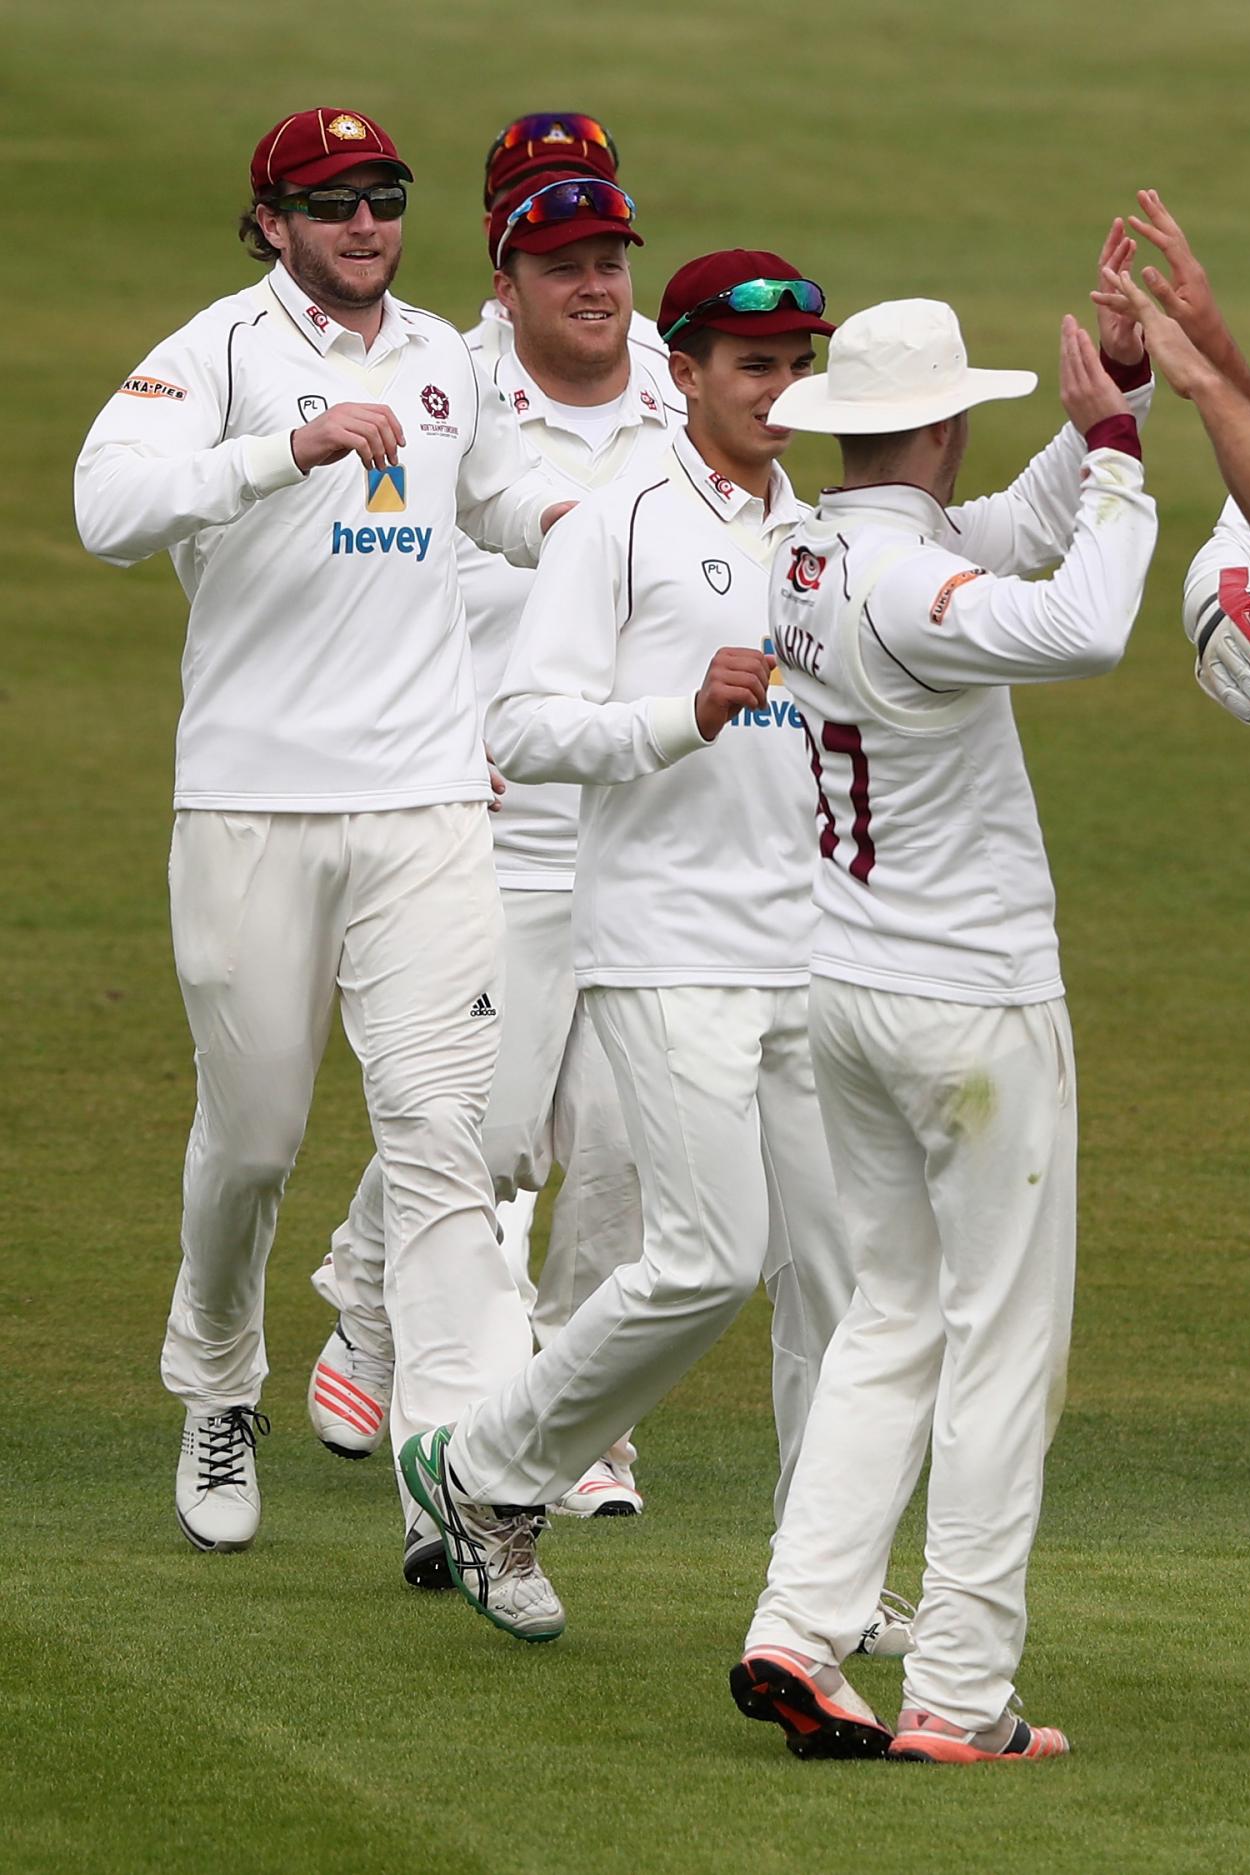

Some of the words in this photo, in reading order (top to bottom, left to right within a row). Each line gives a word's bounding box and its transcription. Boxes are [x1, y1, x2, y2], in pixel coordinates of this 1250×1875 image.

[123, 380, 185, 398] KKA-PIES
[332, 522, 433, 561] hevey
[801, 712, 875, 886] 7
[470, 1007, 496, 1016] adidas
